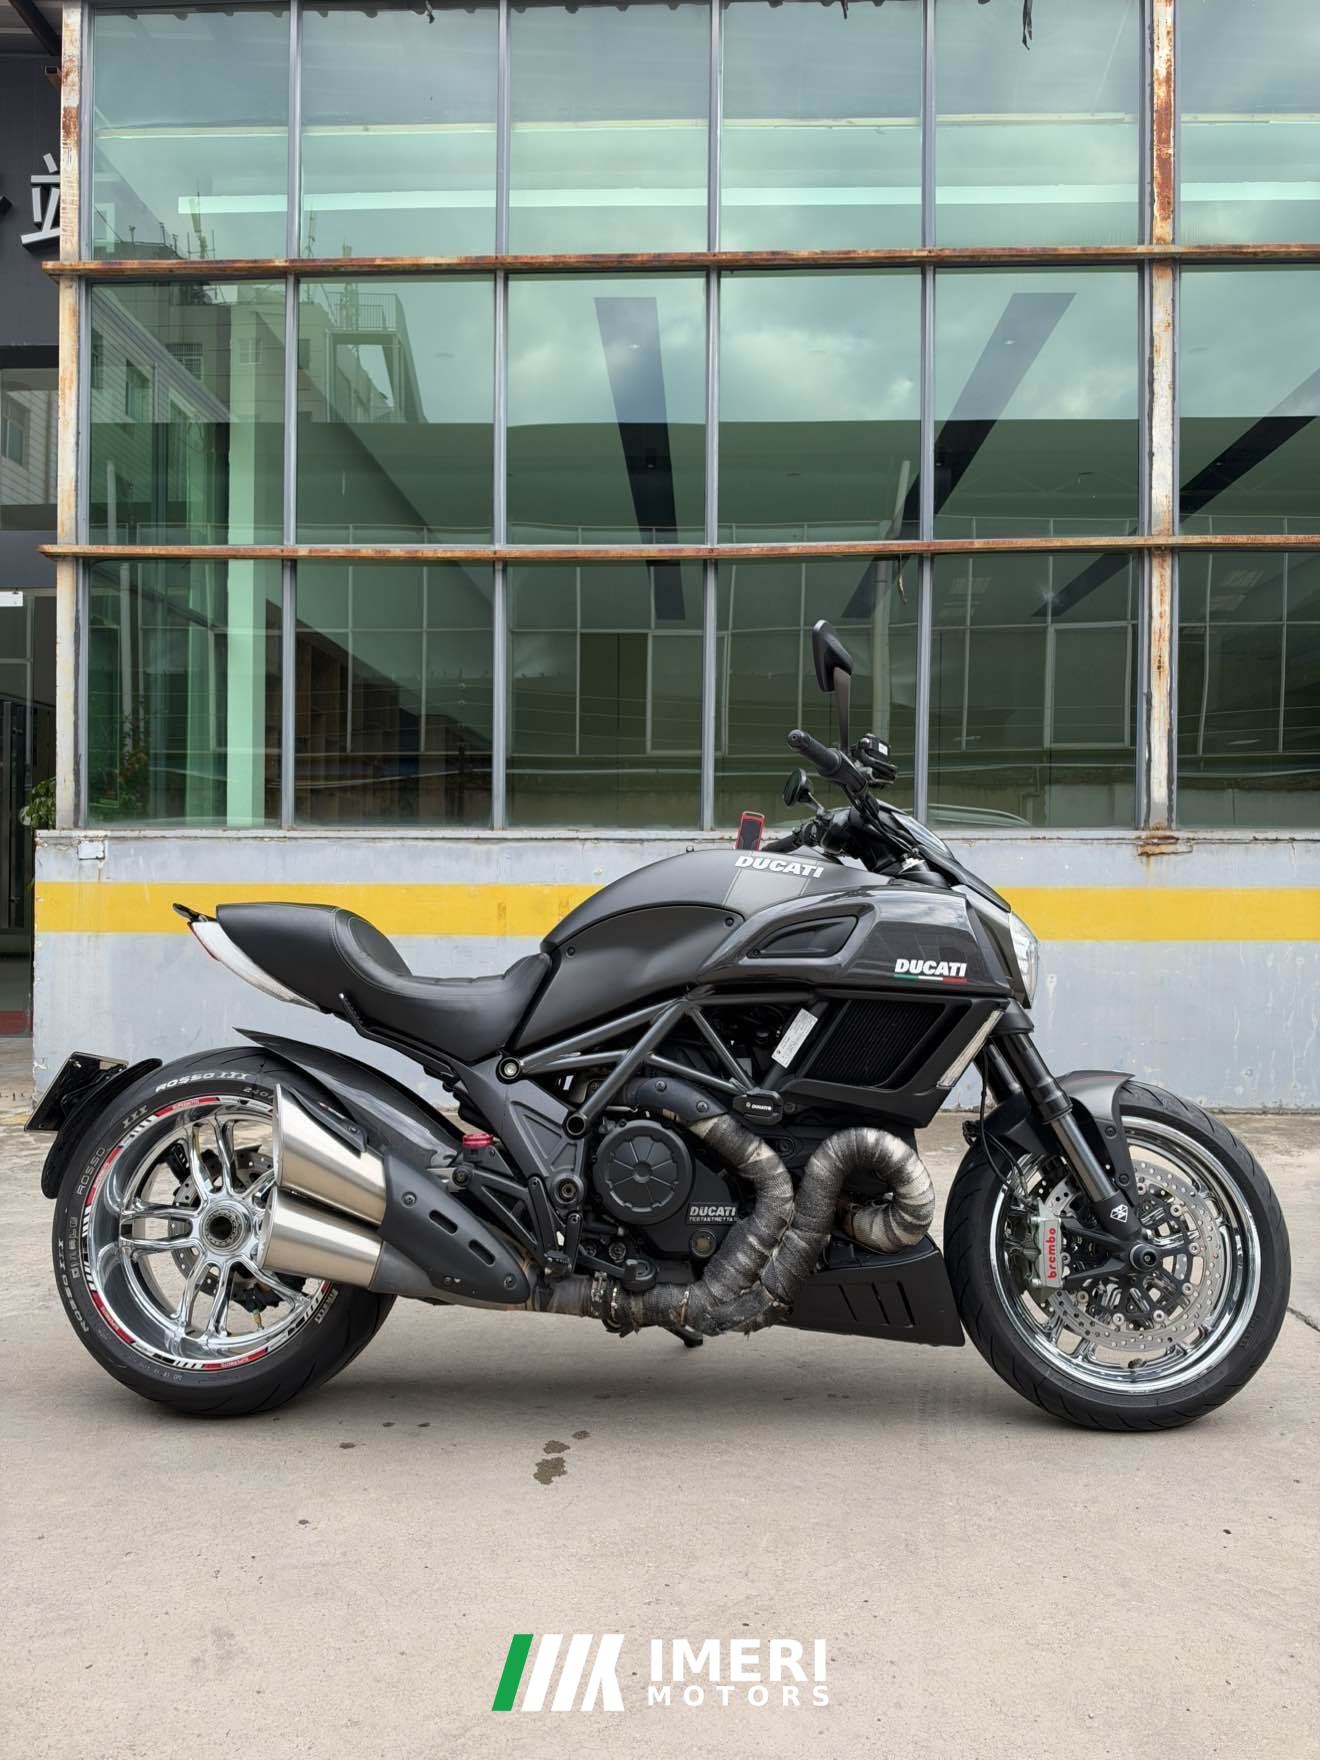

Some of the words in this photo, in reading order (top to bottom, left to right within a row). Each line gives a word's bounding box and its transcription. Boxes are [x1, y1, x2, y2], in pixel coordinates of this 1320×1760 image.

[735, 855, 825, 879] DUCATI
[894, 958, 968, 977] DUCATI
[155, 1072, 216, 1093] ROSSO
[76, 1146, 106, 1195] ROSSO
[689, 1206, 737, 1217] DUCATI
[1046, 1227, 1058, 1279] brembo
[61, 1273, 90, 1333] ROSSO
